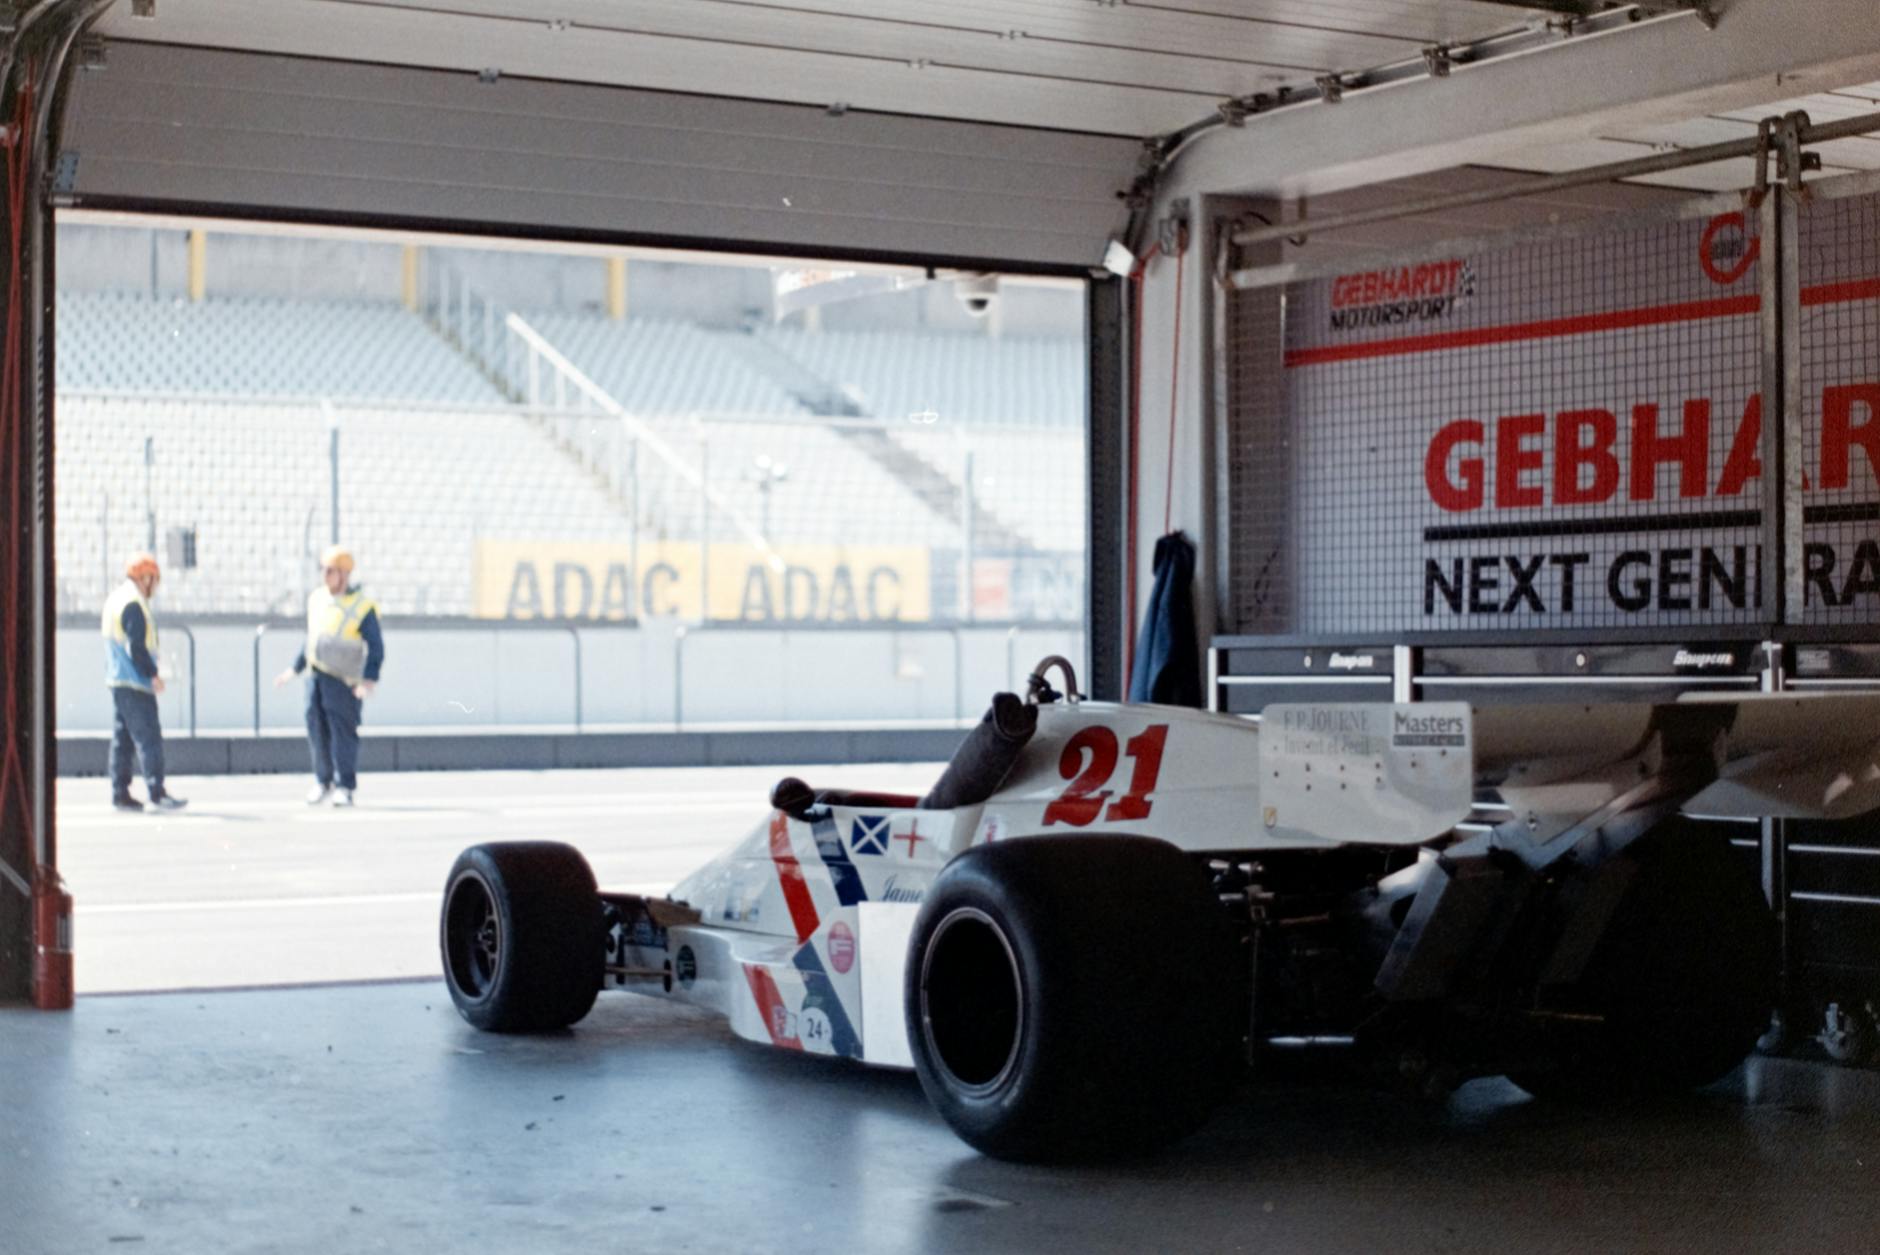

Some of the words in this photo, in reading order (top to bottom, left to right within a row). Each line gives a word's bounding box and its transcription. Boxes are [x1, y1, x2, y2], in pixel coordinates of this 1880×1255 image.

[1332, 258, 1466, 310] GEBHARDT
[1330, 295, 1455, 331] MOTORSPORT
[504, 560, 681, 619] ADAC
[741, 564, 902, 620] ADAC
[1424, 553, 1590, 616] NEXT
[1607, 539, 1880, 614] GENRA
[1394, 710, 1464, 733] Masters
[1042, 724, 1169, 827] 21
[806, 1016, 823, 1040] 24
